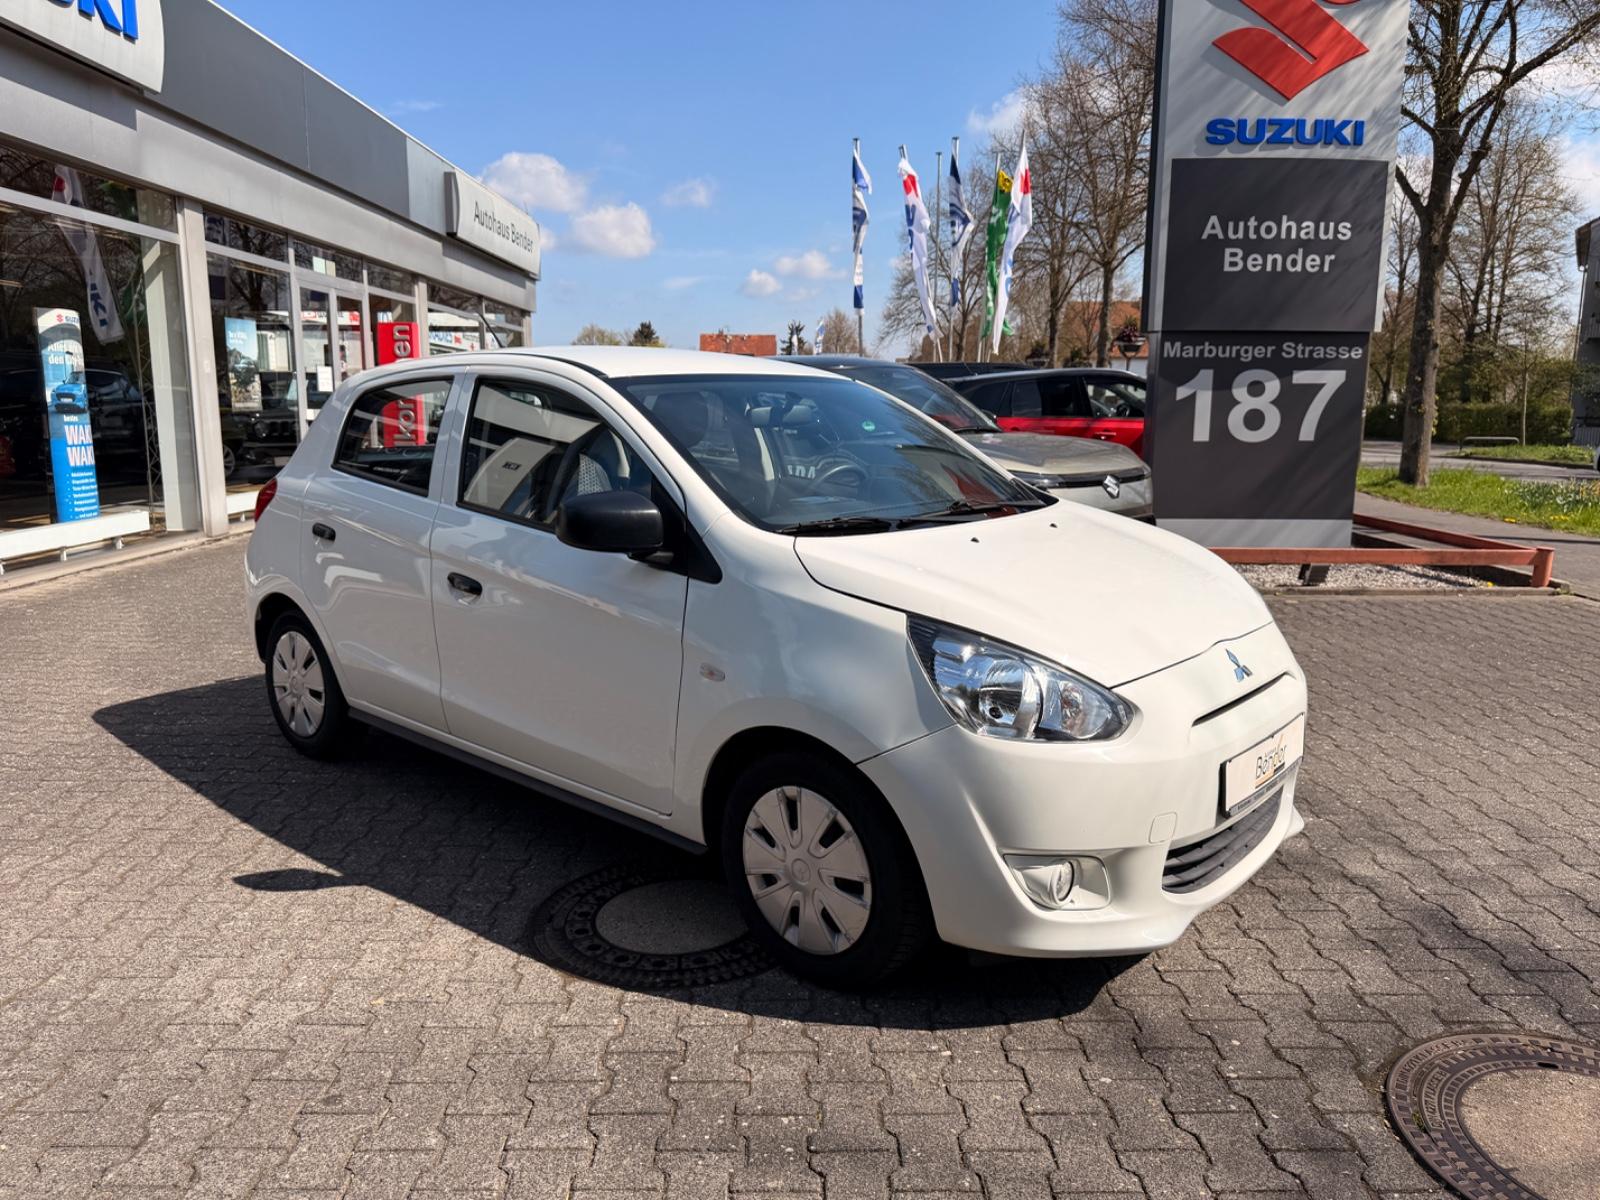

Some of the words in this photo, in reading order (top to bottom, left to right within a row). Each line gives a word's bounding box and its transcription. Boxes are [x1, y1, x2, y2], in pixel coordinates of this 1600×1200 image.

[1205, 118, 1365, 146] SUZUKI
[474, 200, 510, 241] Autohaus
[511, 222, 533, 253] Bender
[1201, 215, 1352, 240] Autohaus
[1223, 248, 1336, 273] Bender
[1163, 341, 1276, 362] Marburger
[1281, 341, 1363, 359] Strasse
[1175, 368, 1347, 443] 187
